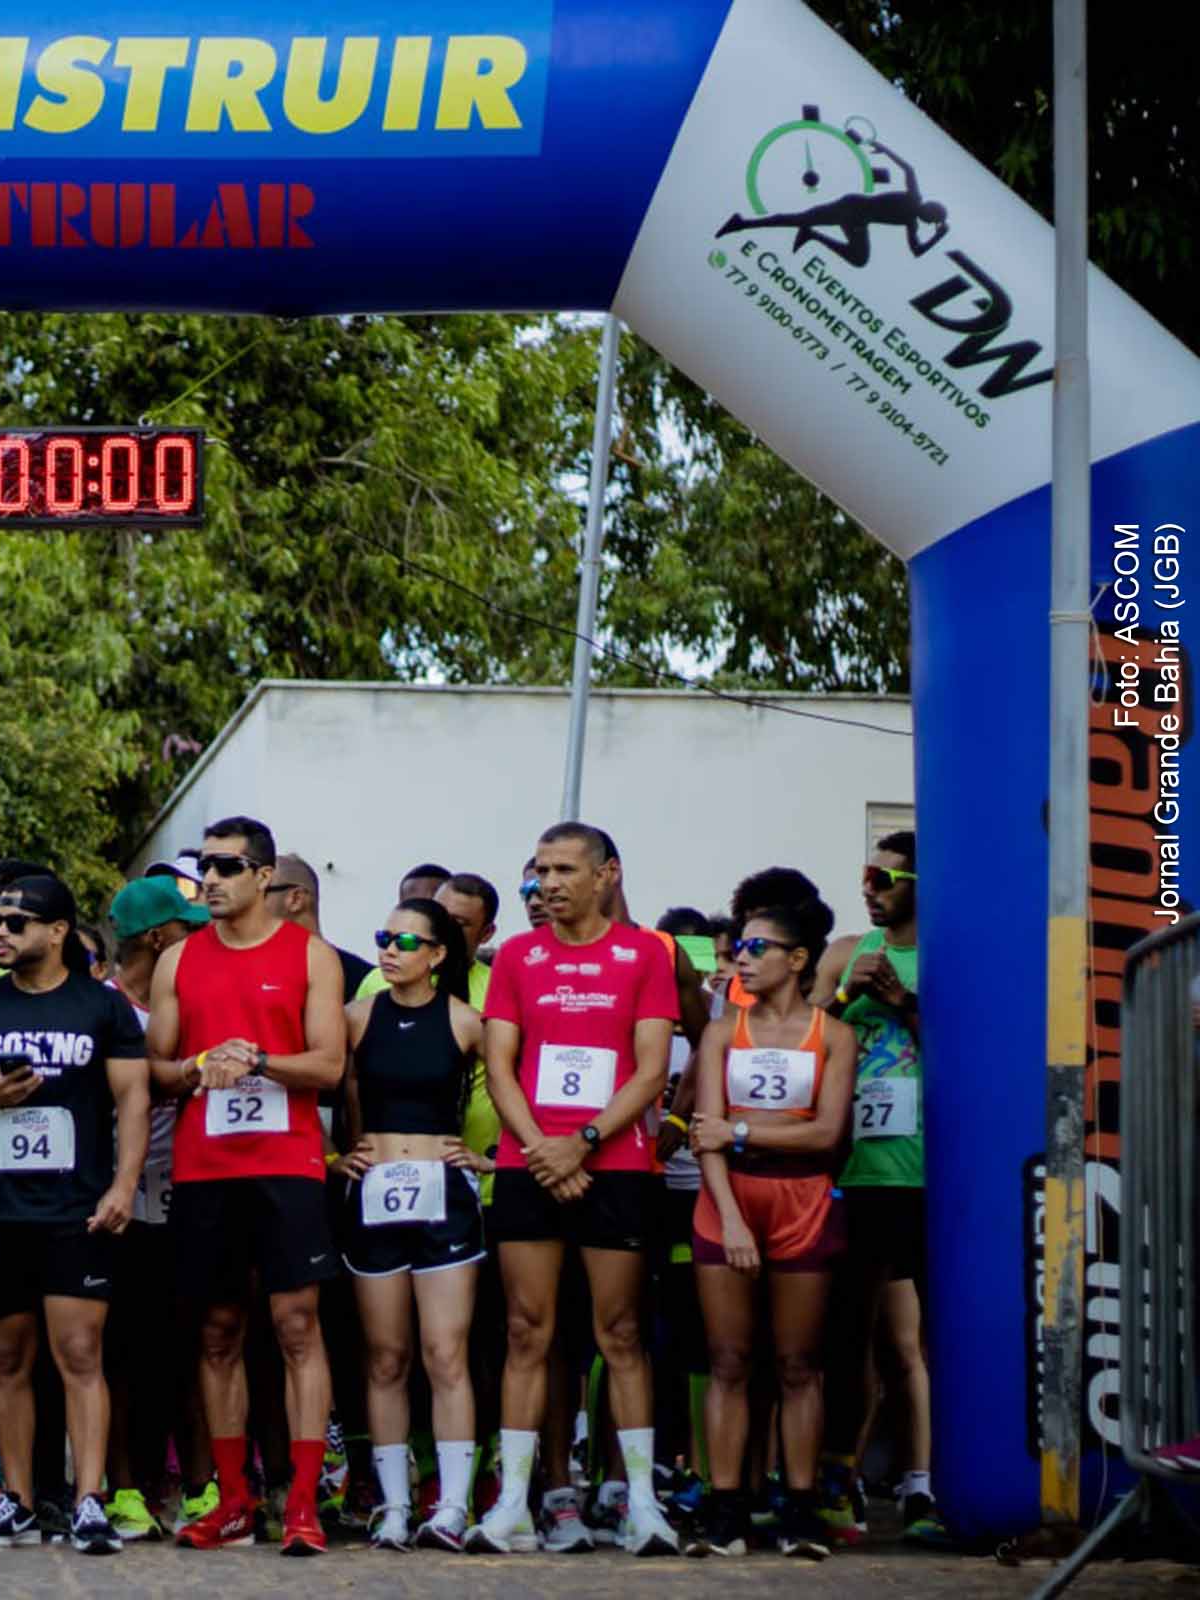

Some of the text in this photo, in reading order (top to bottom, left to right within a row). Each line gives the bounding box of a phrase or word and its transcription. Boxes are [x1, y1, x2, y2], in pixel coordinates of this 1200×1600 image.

[724, 265, 749, 286] 77
[745, 283, 759, 298] 9
[757, 294, 830, 362] 9100-6773
[845, 372, 869, 393] 77
[865, 390, 880, 406] 9
[757, 252, 913, 395] CRONOMETRAGEM
[803, 256, 992, 429] EVENTOS ESPORTIVOS
[562, 1072, 580, 1096] 8
[749, 1075, 788, 1100] 23
[227, 1096, 263, 1123] 52
[861, 1103, 894, 1128] 27
[12, 1134, 50, 1160] 94
[384, 1187, 421, 1213] 67
